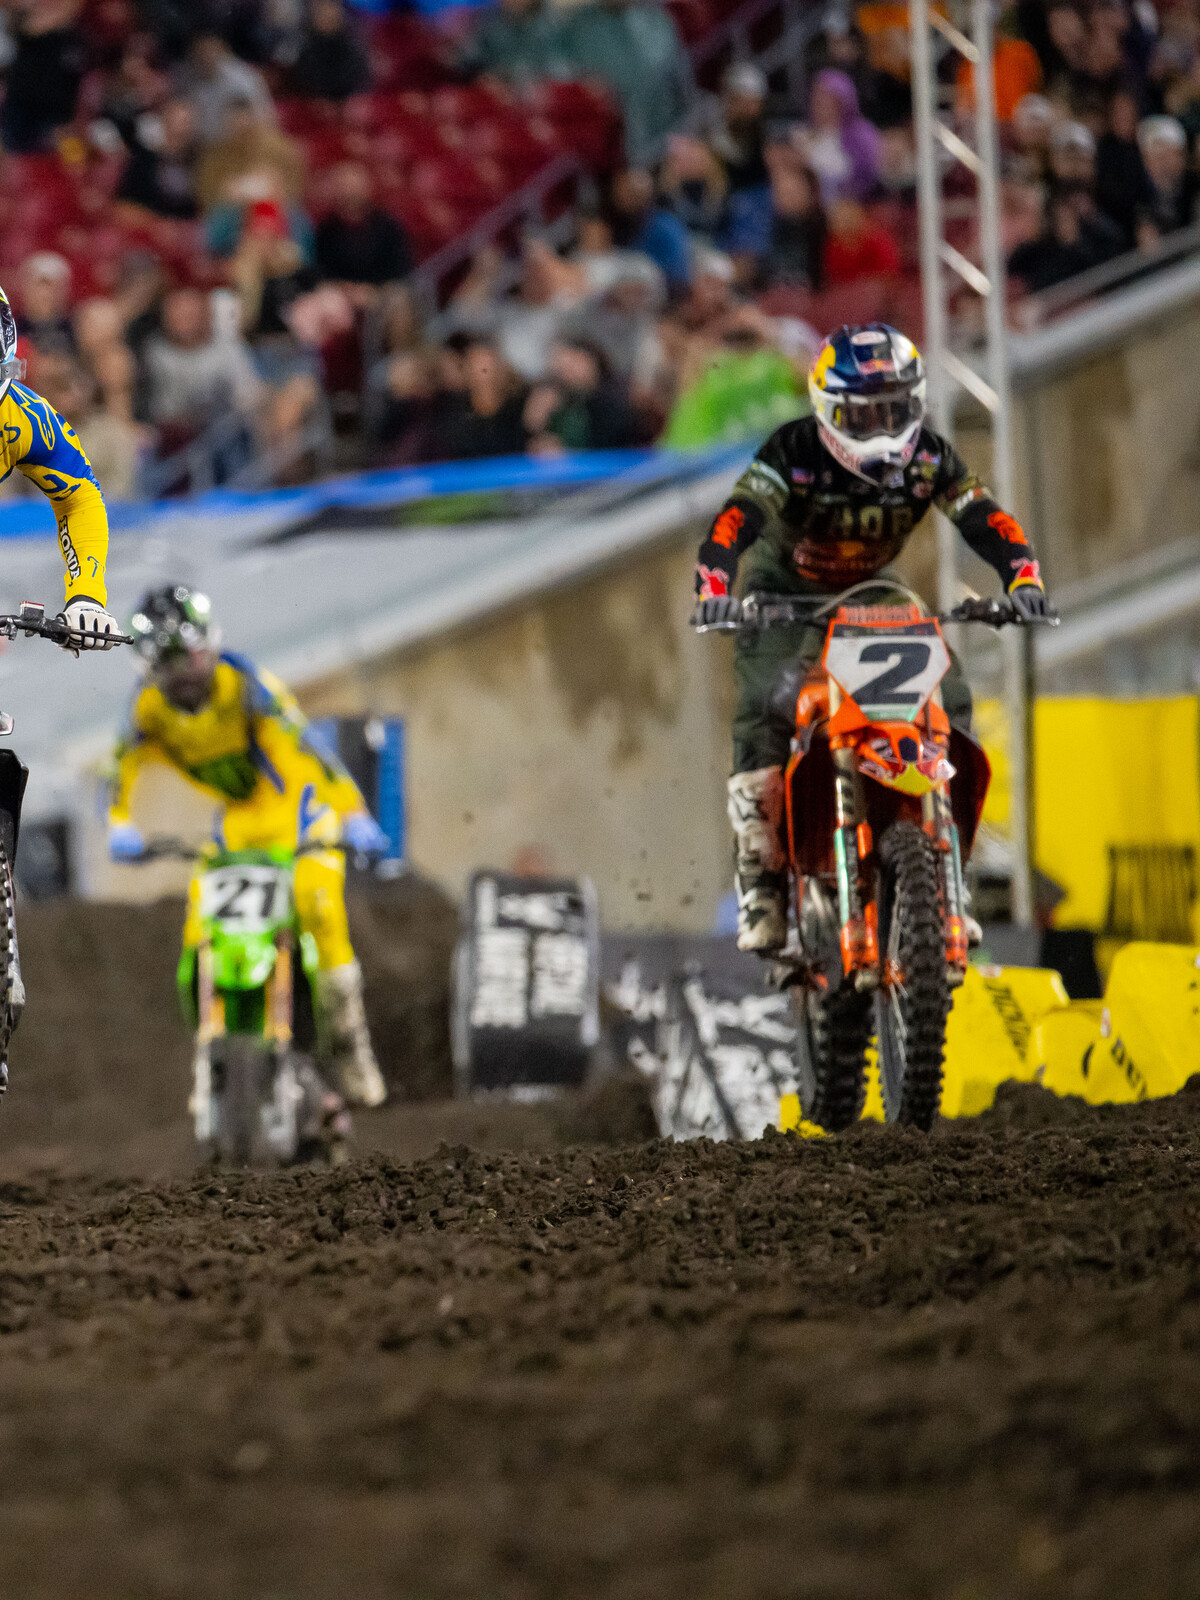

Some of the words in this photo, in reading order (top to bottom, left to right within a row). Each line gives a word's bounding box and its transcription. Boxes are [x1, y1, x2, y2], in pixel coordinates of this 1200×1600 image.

[59, 515, 81, 580] HONDA
[852, 643, 931, 705] 2
[215, 879, 276, 920] 21
